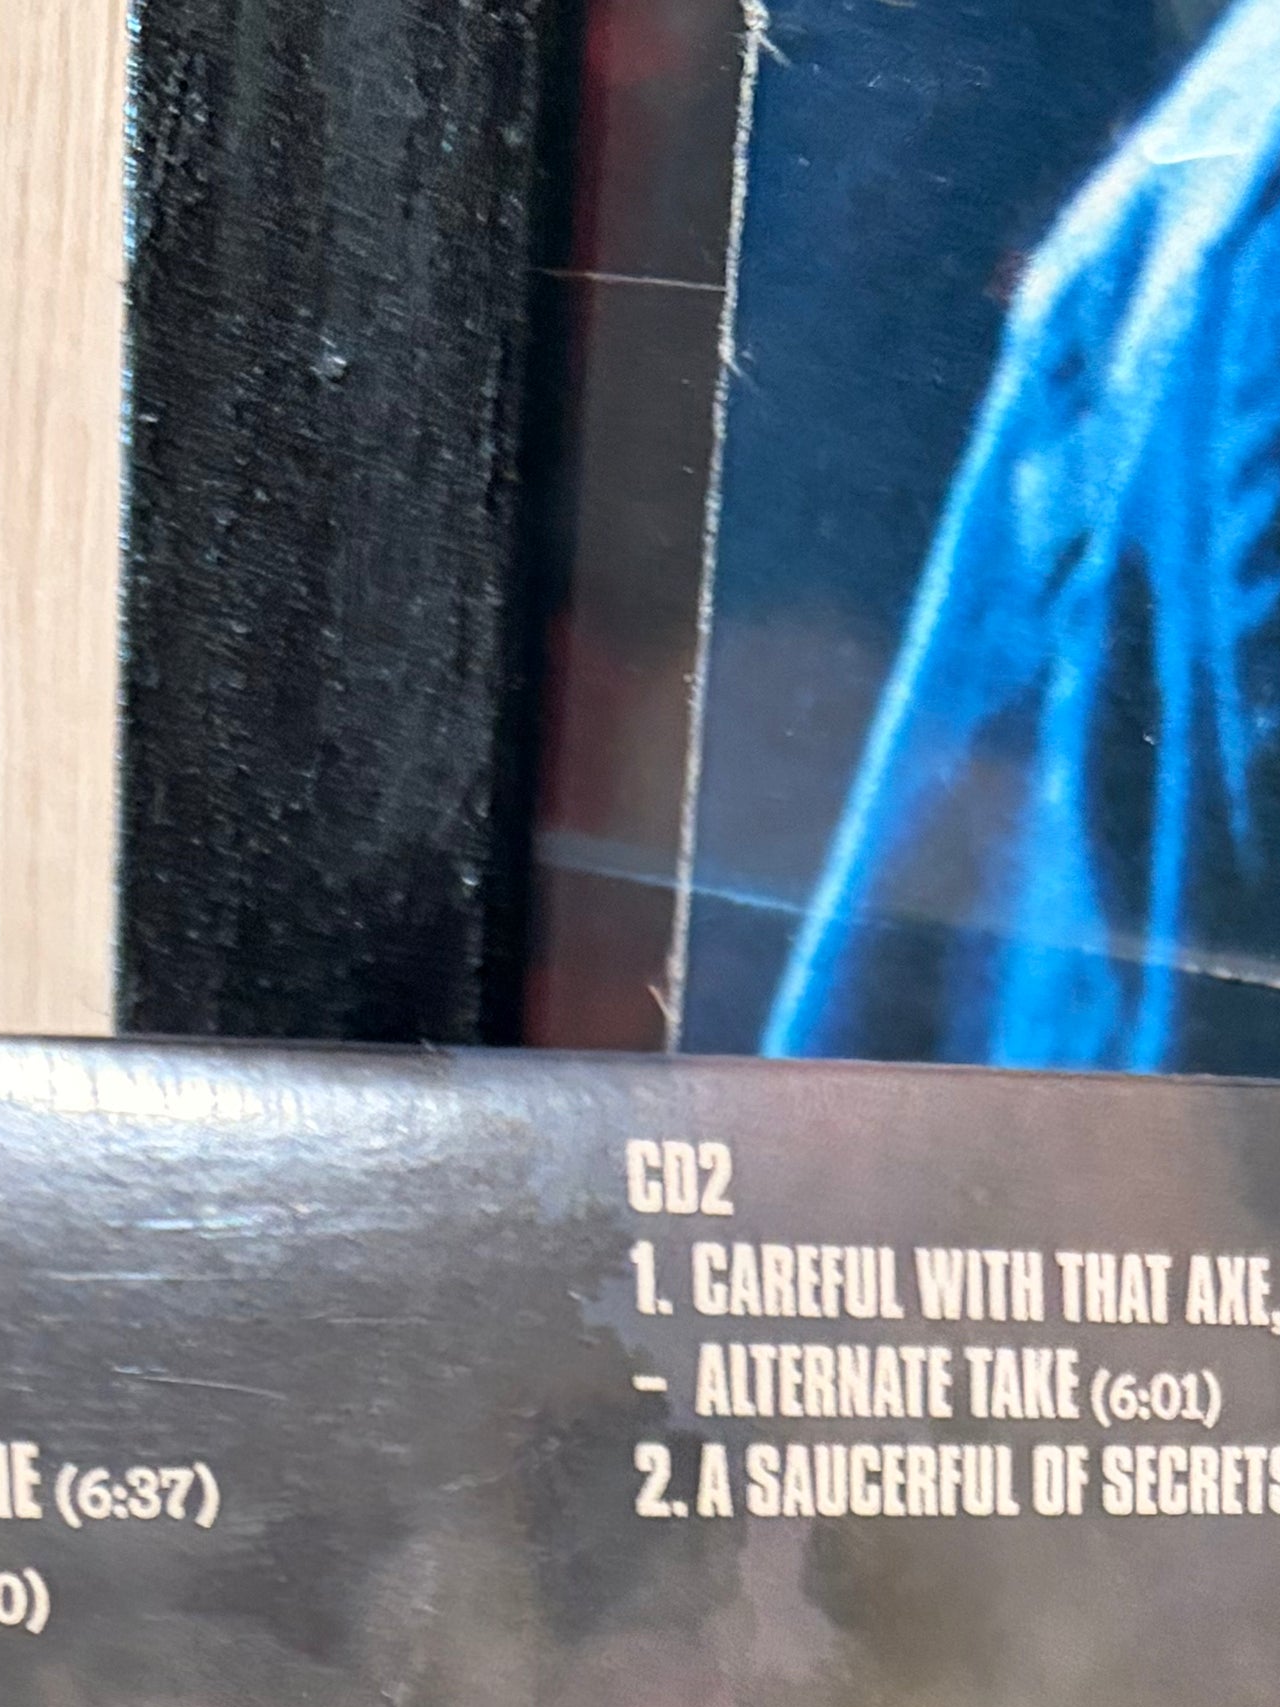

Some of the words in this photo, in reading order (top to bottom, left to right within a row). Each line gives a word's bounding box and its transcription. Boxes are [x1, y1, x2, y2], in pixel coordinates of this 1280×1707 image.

[626, 1139, 733, 1214] CD2
[631, 1241, 672, 1314] 1.
[694, 1242, 903, 1318] CAREFUL
[916, 1248, 1043, 1321] WITH
[1056, 1252, 1171, 1323] THAT
[698, 1344, 951, 1417] ALTERNATE
[965, 1347, 1079, 1418] TAKE
[1092, 1369, 1221, 1428] (6:01)
[56, 1463, 219, 1528] (6:37)
[635, 1443, 688, 1517] 2.
[698, 1444, 733, 1516] A
[748, 1445, 1019, 1516] SAUCERFUL
[1034, 1445, 1088, 1515] OF
